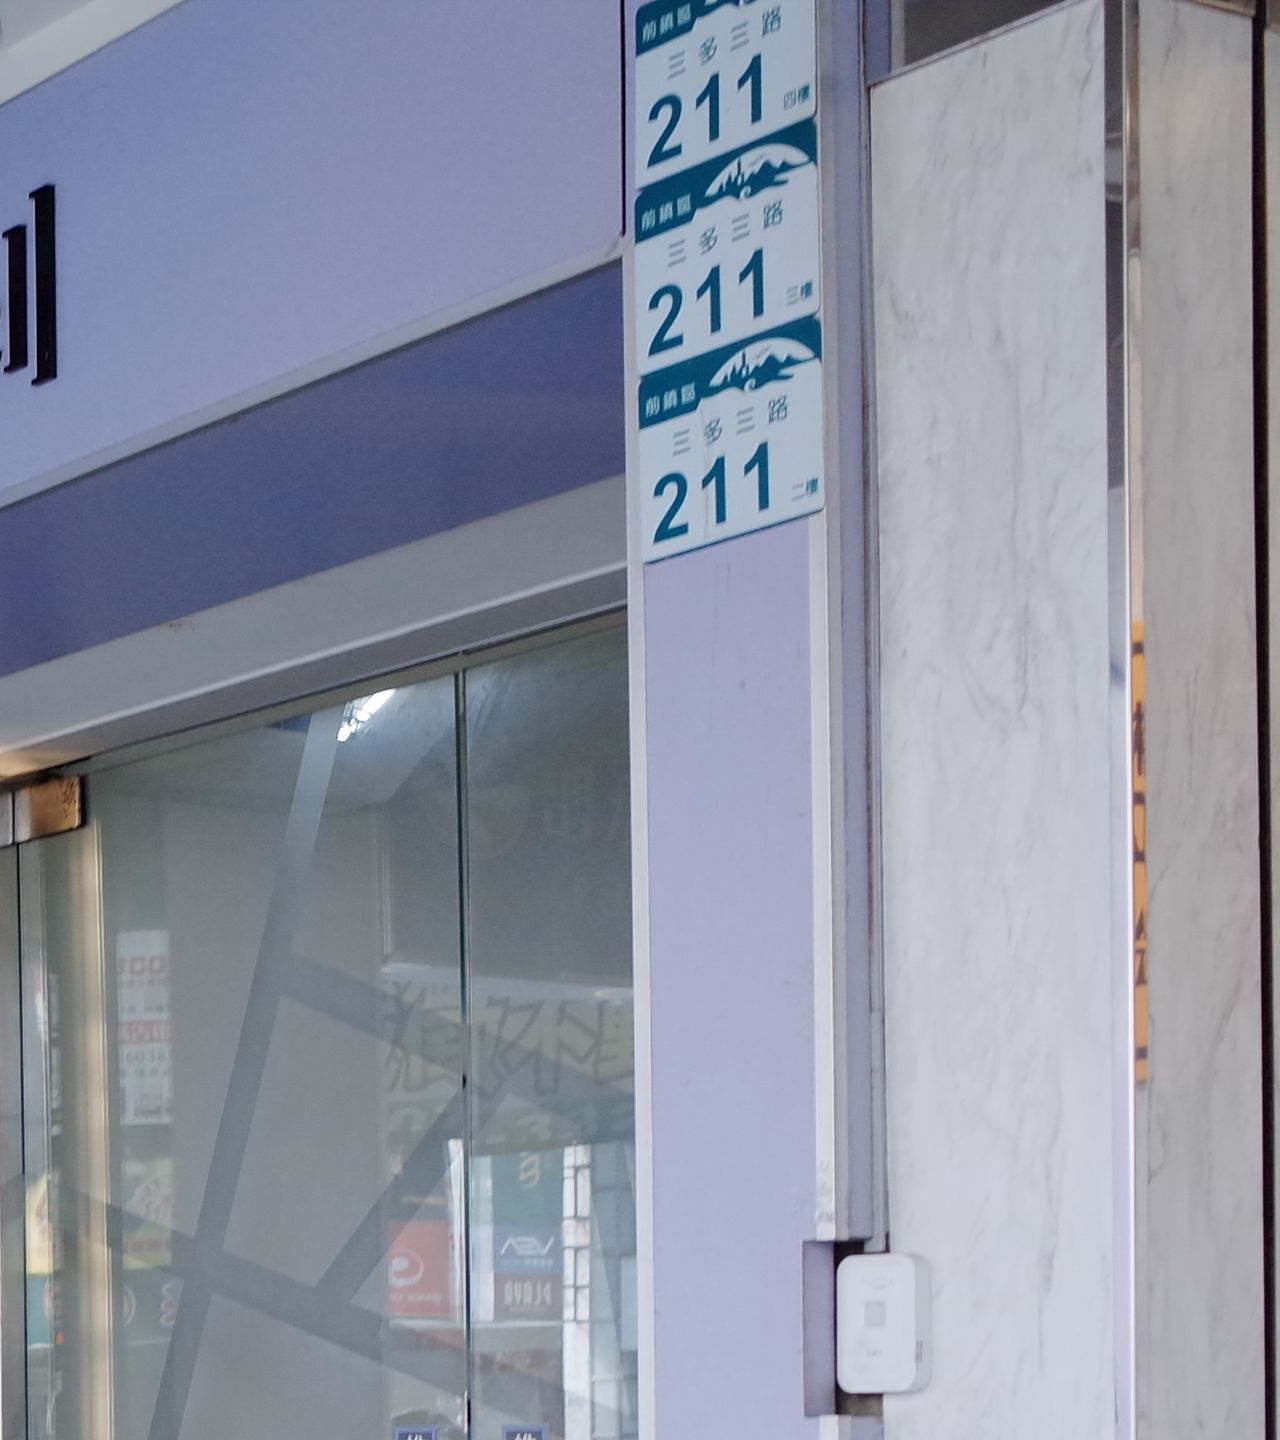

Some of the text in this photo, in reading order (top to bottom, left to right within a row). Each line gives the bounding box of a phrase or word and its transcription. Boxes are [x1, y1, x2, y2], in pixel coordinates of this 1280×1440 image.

[642, 4, 691, 43] 前鎮區
[668, 6, 782, 80] 三多三路
[647, 52, 762, 169] 211
[783, 84, 810, 110] 四樓
[641, 193, 691, 232] 前鎮區
[668, 200, 784, 268] 三多三路
[648, 247, 764, 358] 211
[785, 281, 814, 307] 三樓
[646, 382, 696, 418] 前鎮區
[673, 394, 788, 457] 三多三路
[653, 440, 770, 545] 211
[791, 478, 819, 502] 二樓
